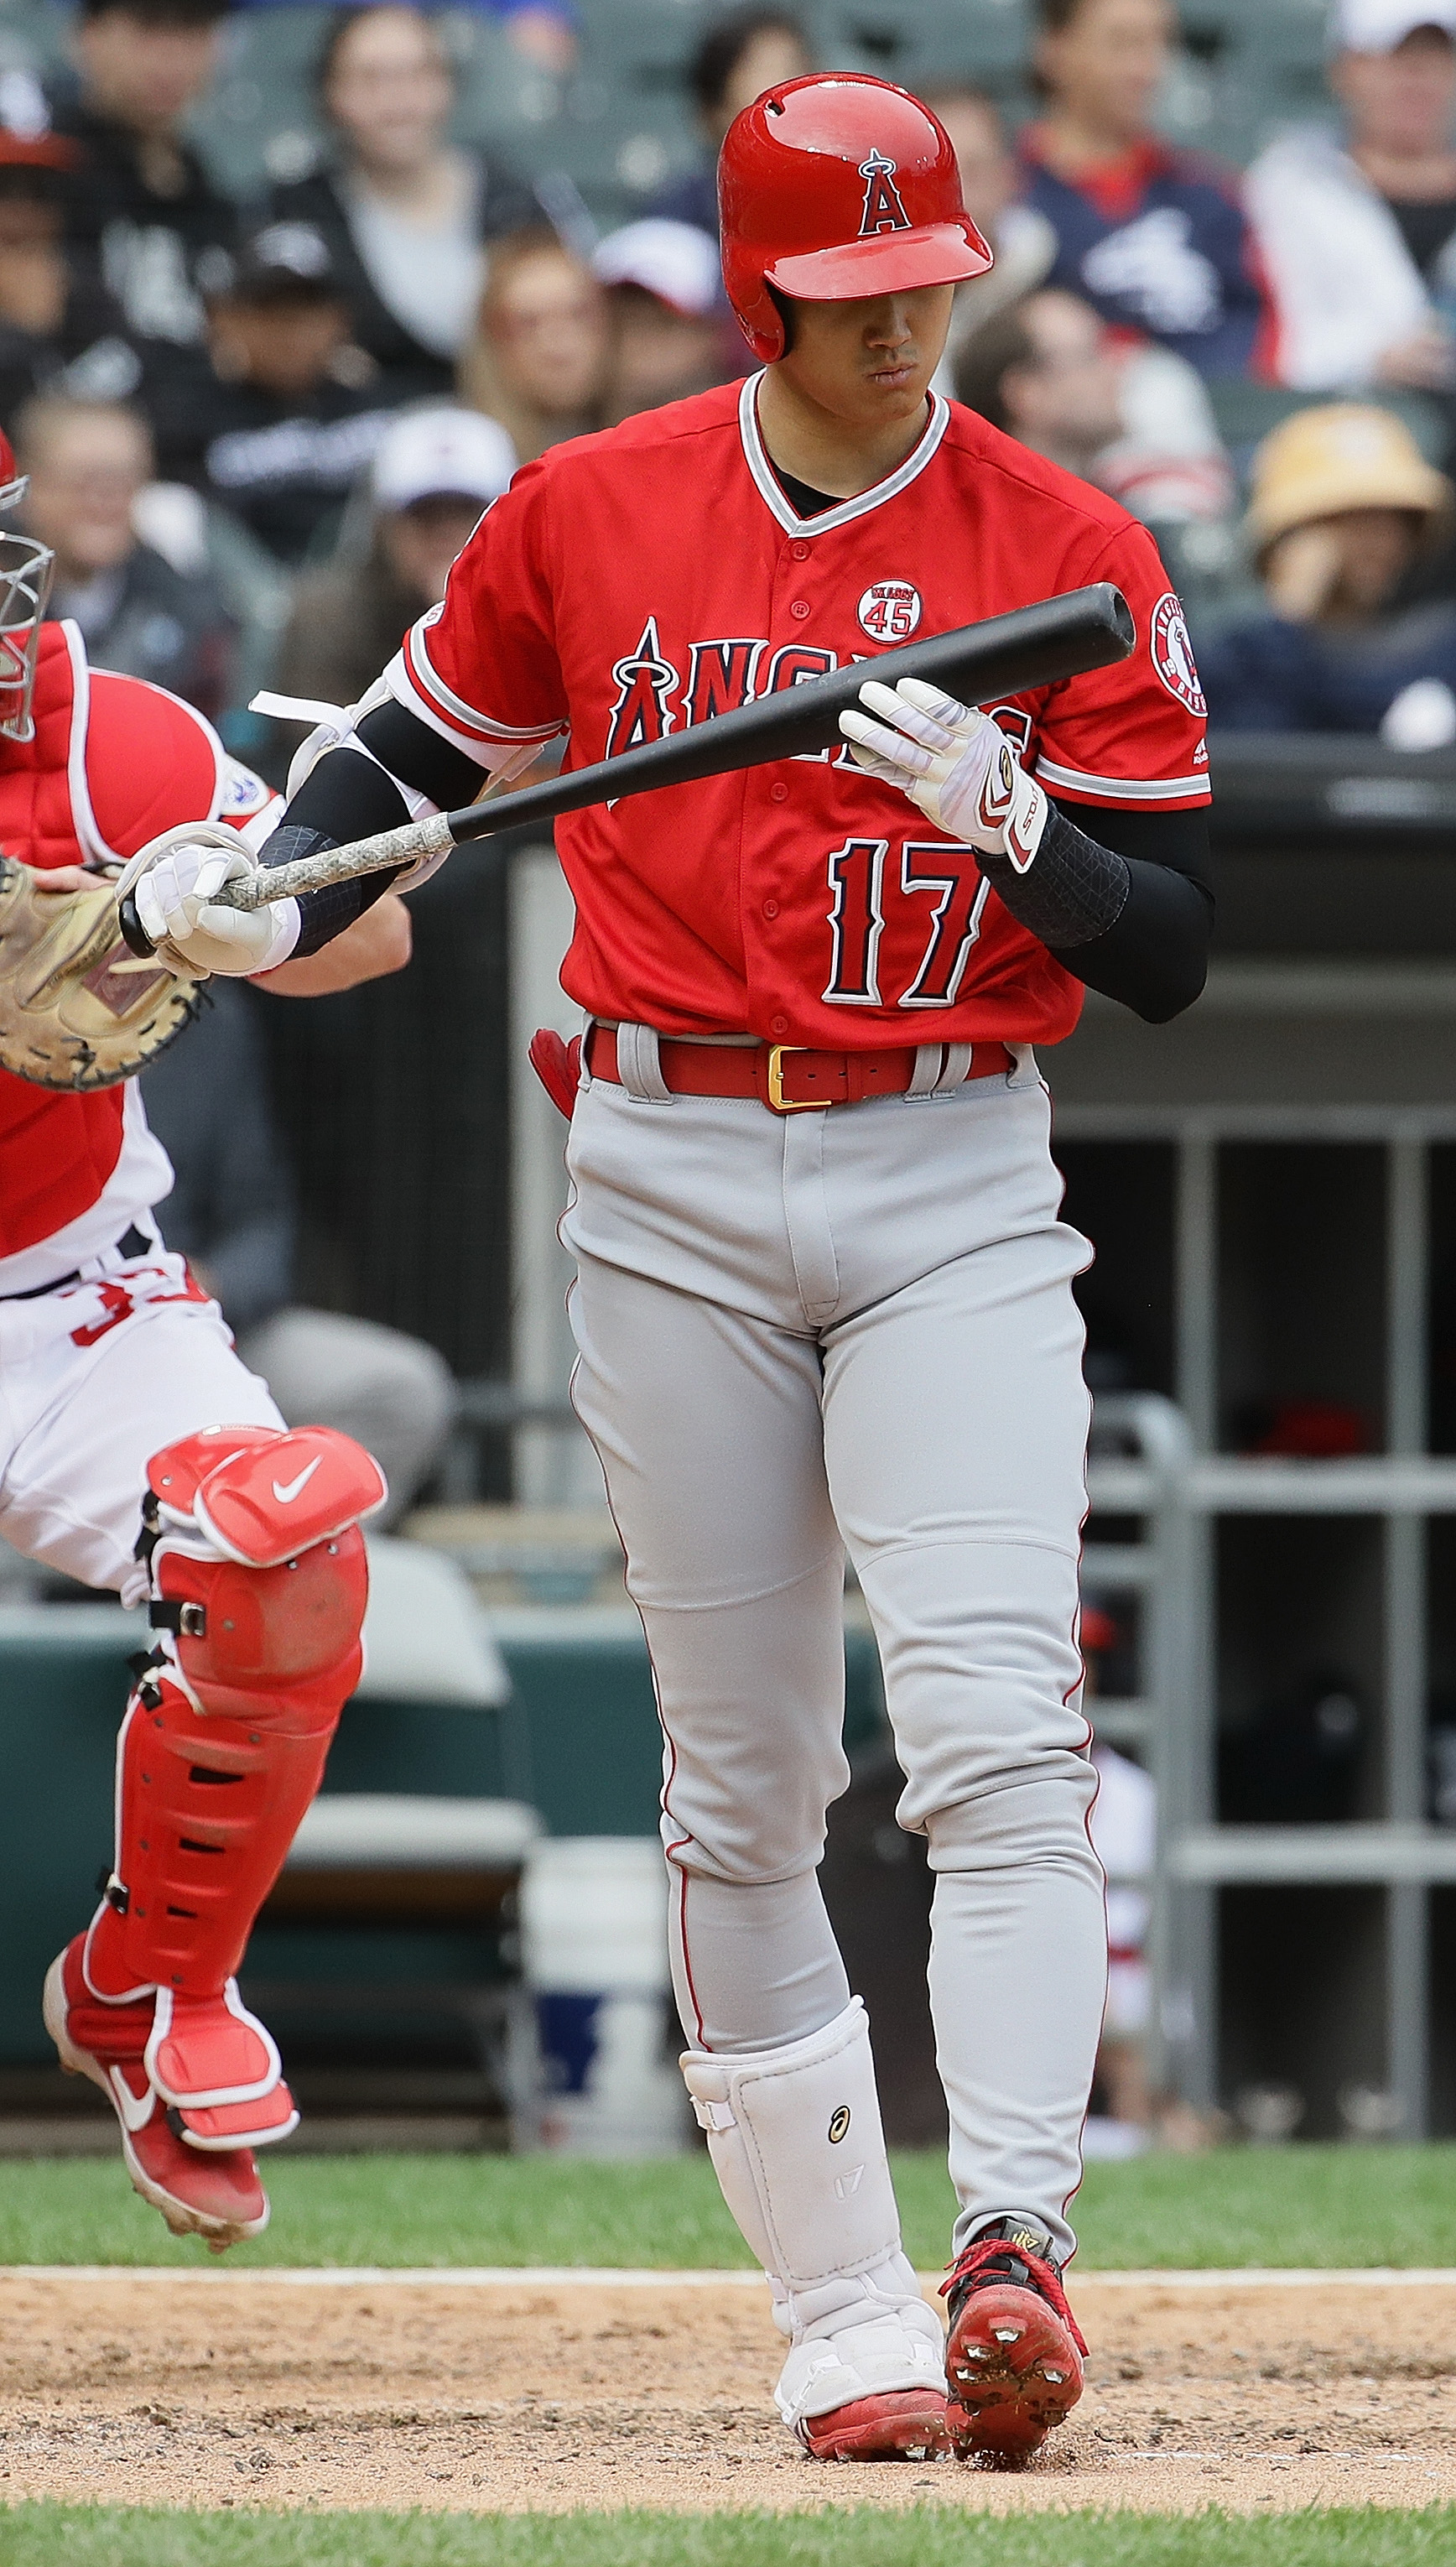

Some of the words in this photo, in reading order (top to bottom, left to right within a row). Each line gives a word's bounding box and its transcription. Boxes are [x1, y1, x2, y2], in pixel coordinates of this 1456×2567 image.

[857, 147, 913, 236] A
[864, 601, 912, 634] 45
[1162, 659, 1176, 677] 19
[821, 837, 991, 1008] 17
[835, 2163, 865, 2200] 17
